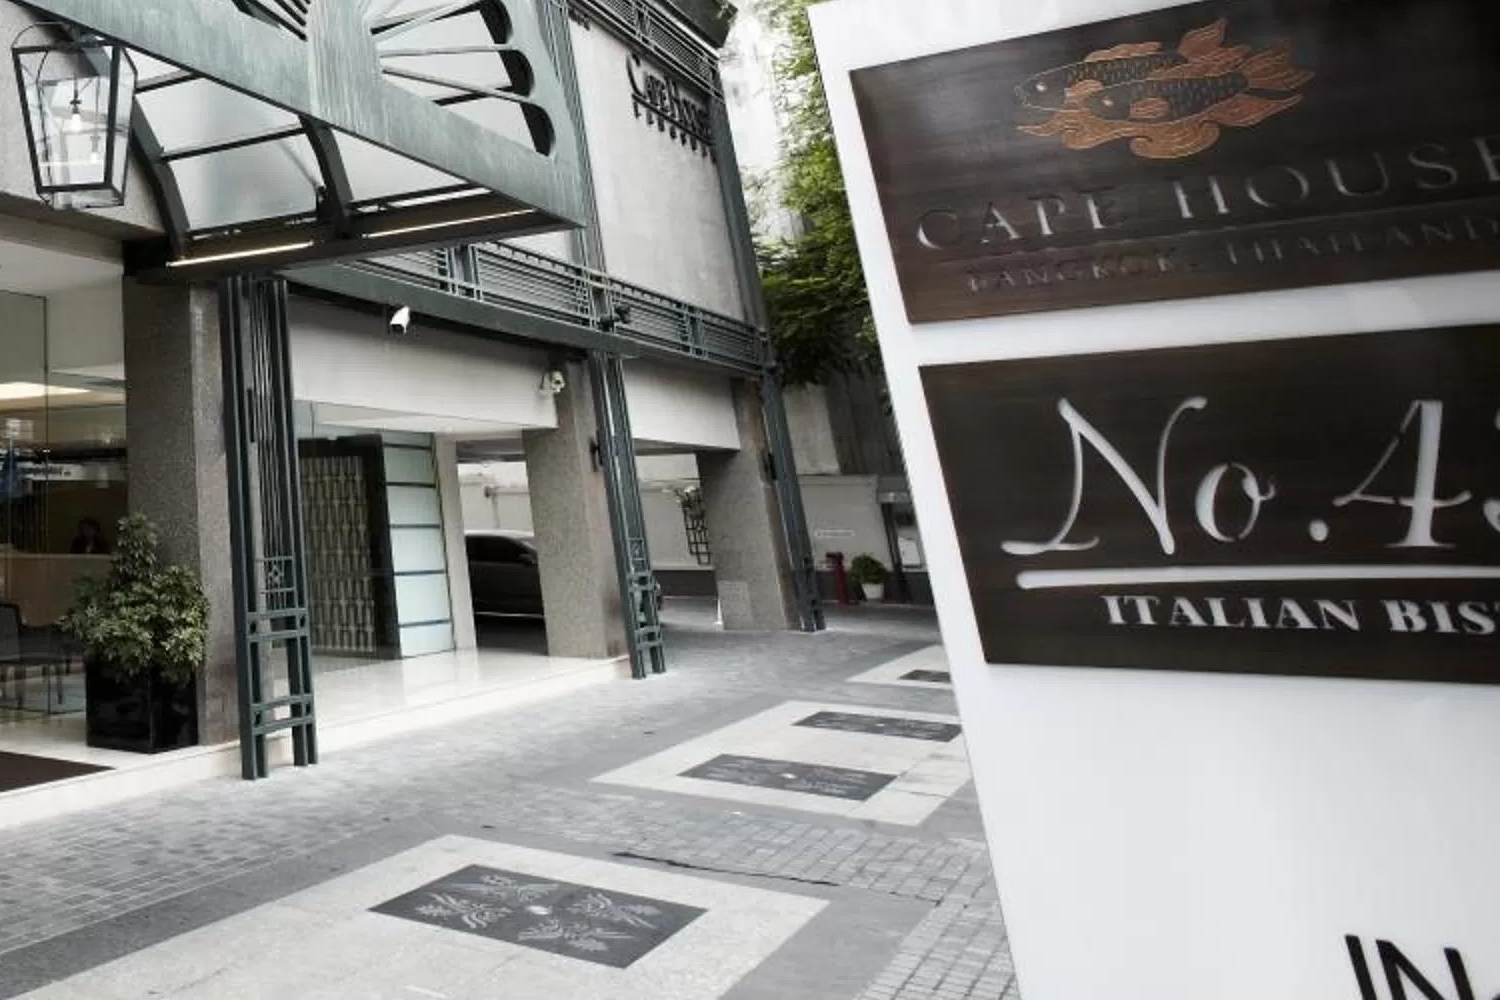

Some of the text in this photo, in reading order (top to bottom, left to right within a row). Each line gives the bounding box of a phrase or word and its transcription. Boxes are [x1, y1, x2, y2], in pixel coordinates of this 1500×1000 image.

[915, 135, 1500, 251] CAPE HOUSE
[1002, 396, 1500, 556] No.4
[1101, 594, 1500, 635] ITALIAN BIS
